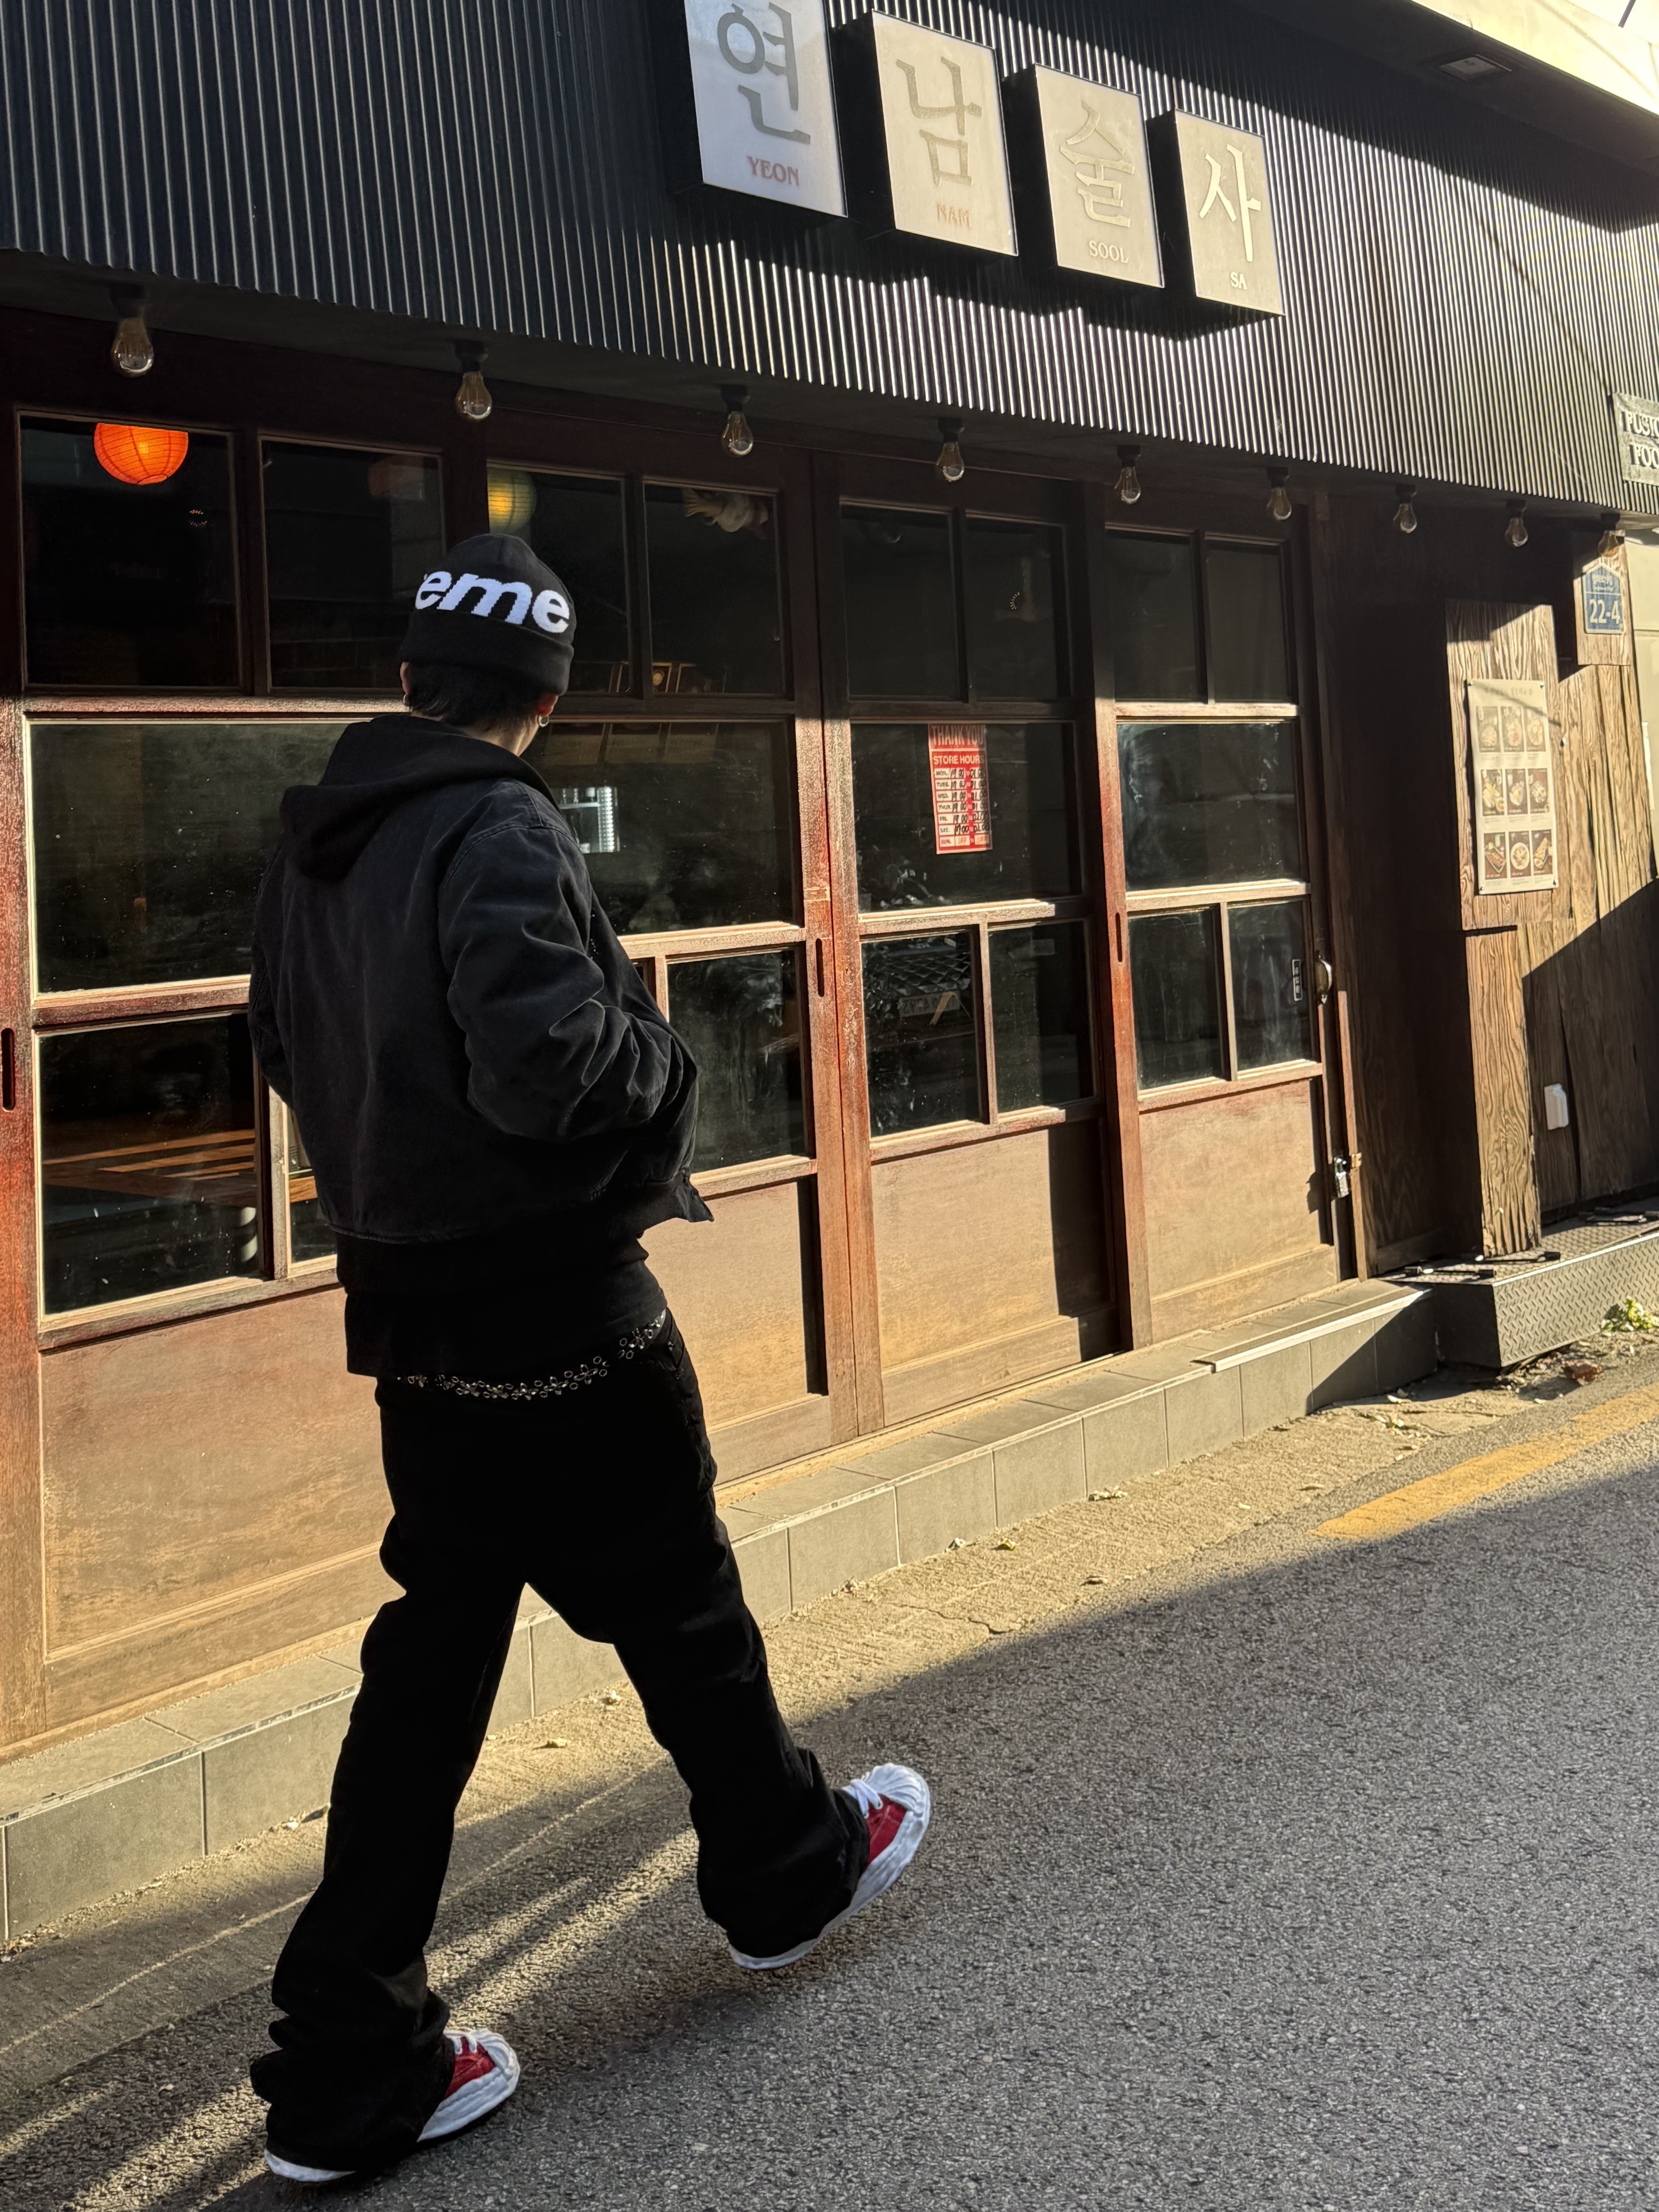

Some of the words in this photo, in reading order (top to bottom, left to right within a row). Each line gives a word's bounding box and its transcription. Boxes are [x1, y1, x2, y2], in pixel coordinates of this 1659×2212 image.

[717, 3, 811, 144] 연
[896, 56, 982, 186] 남
[747, 156, 799, 186] YEON
[1060, 100, 1135, 228] 술
[936, 203, 971, 230] NAM
[1199, 144, 1261, 262] 사
[1088, 240, 1129, 264] SOOL
[1230, 272, 1248, 290] SA
[415, 571, 569, 633] eme
[1589, 599, 1620, 624] 22-4
[931, 725, 965, 745] THANK
[966, 724, 984, 745] YOU
[933, 755, 958, 765] STORE
[960, 754, 984, 764] HOURS
